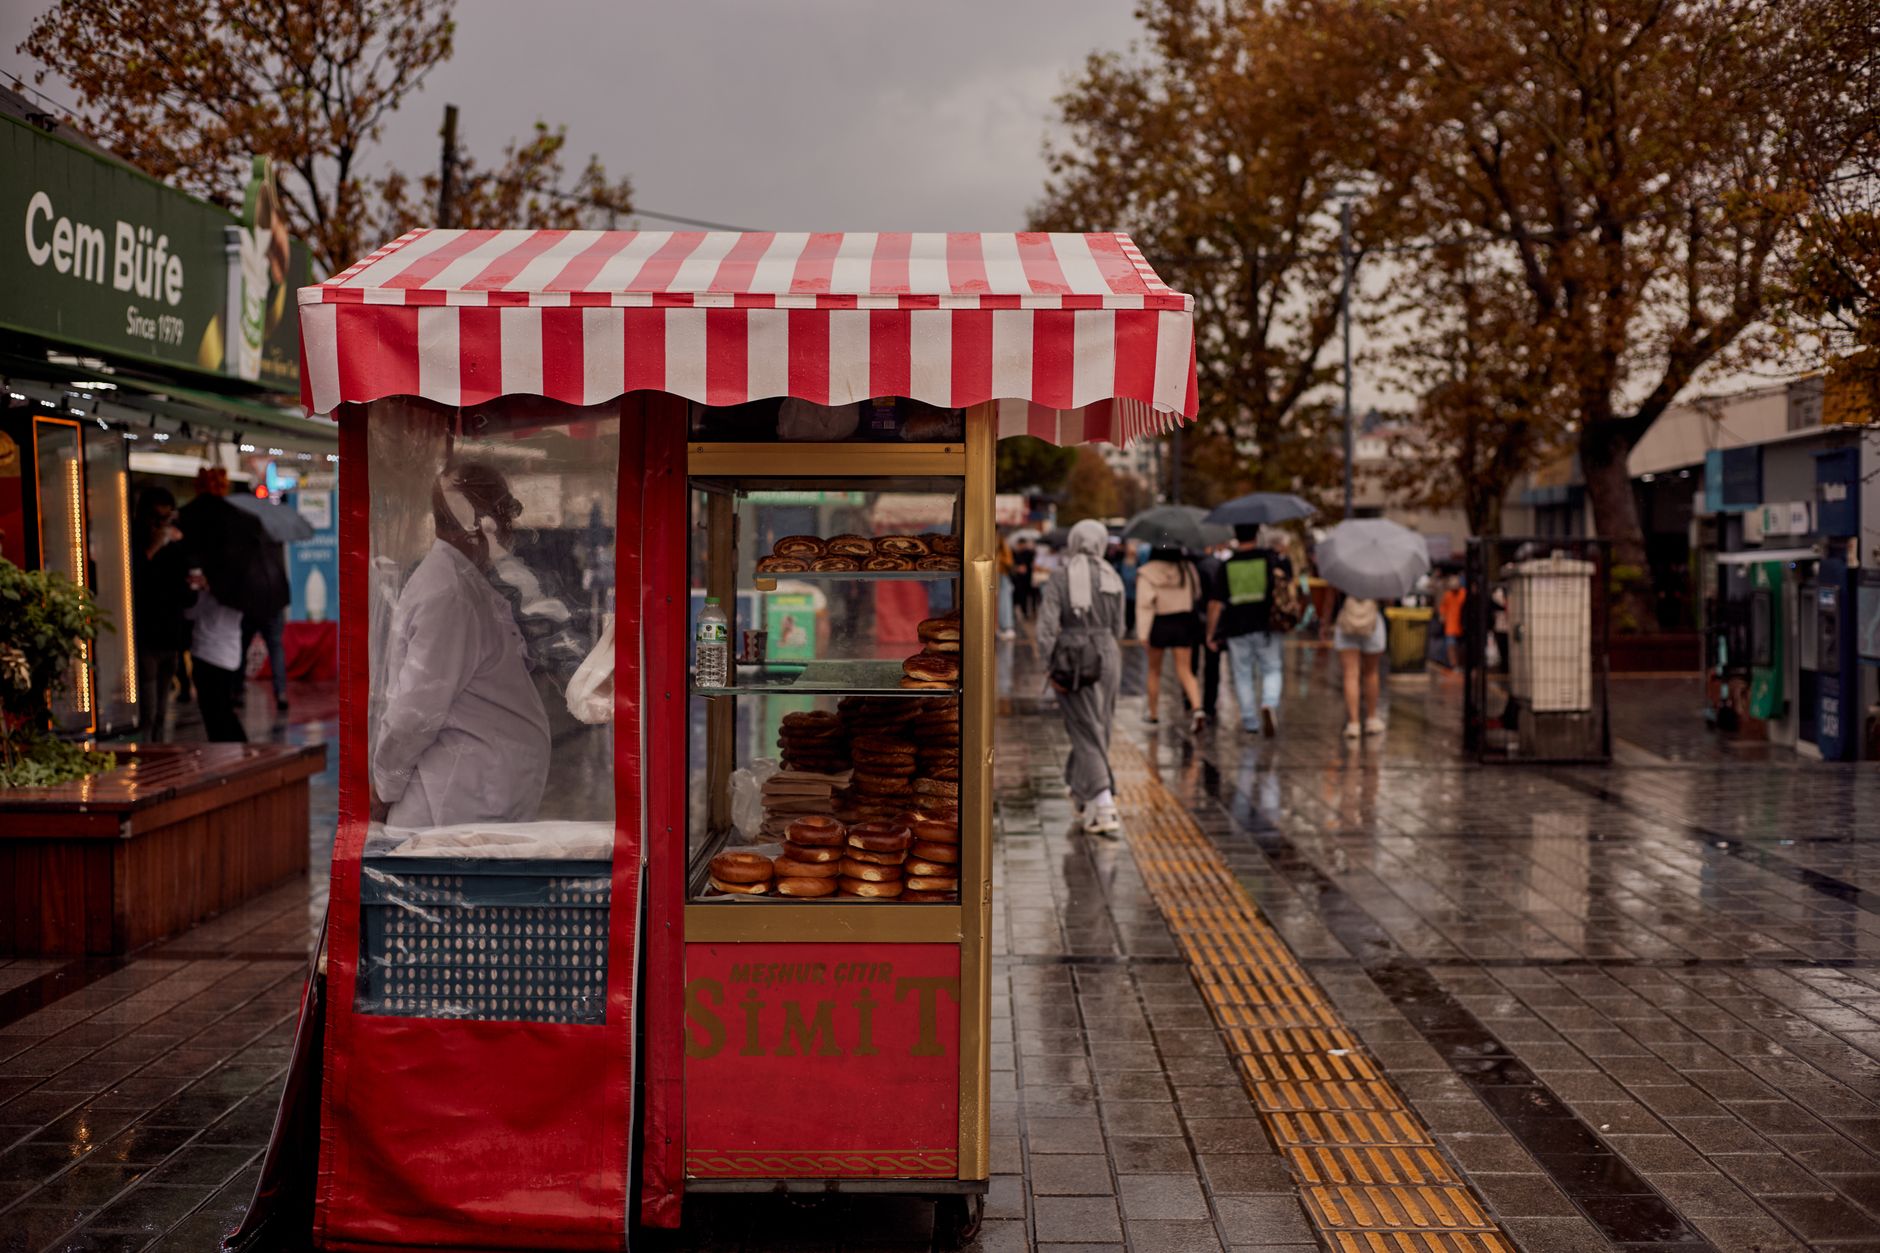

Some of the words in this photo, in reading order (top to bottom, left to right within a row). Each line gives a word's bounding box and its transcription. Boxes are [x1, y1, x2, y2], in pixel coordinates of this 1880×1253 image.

[25, 191, 105, 284] Cem
[113, 220, 184, 306] Büfe
[126, 305, 156, 340] Since
[158, 314, 184, 345] 1979
[729, 961, 827, 988] MEŞHUR
[833, 961, 894, 988] ÇITIR
[685, 976, 960, 1060] SİMİT
